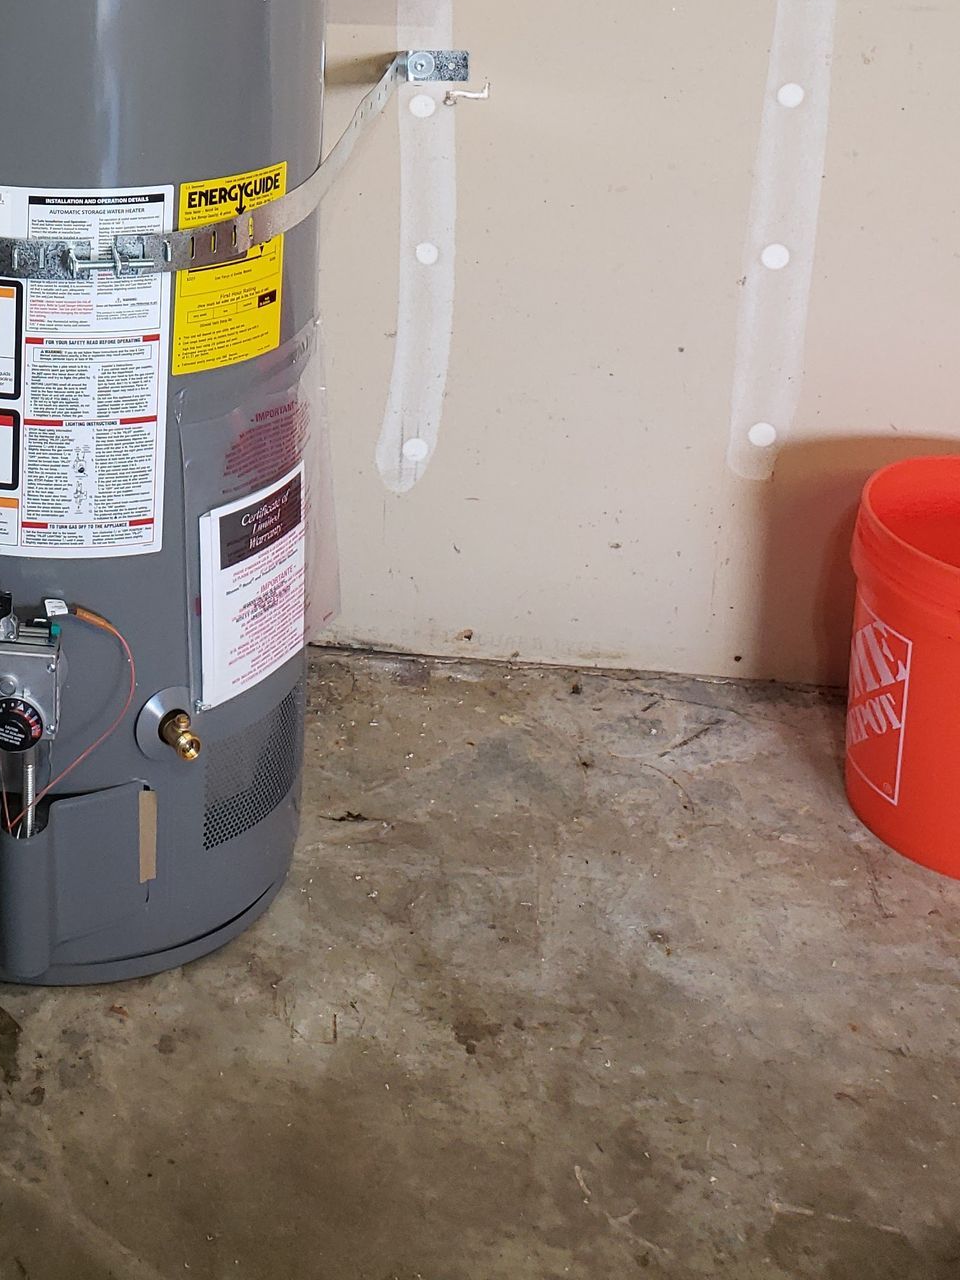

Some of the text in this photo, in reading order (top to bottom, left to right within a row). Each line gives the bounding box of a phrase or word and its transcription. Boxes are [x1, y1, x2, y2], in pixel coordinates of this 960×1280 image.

[188, 172, 280, 209] ENERGYGUIDE
[256, 400, 295, 421] IMPORTANT
[241, 488, 290, 527] Certificate of
[252, 510, 281, 535] Limited
[249, 523, 282, 549] Warranty
[260, 566, 293, 592] IMPORTANTE
